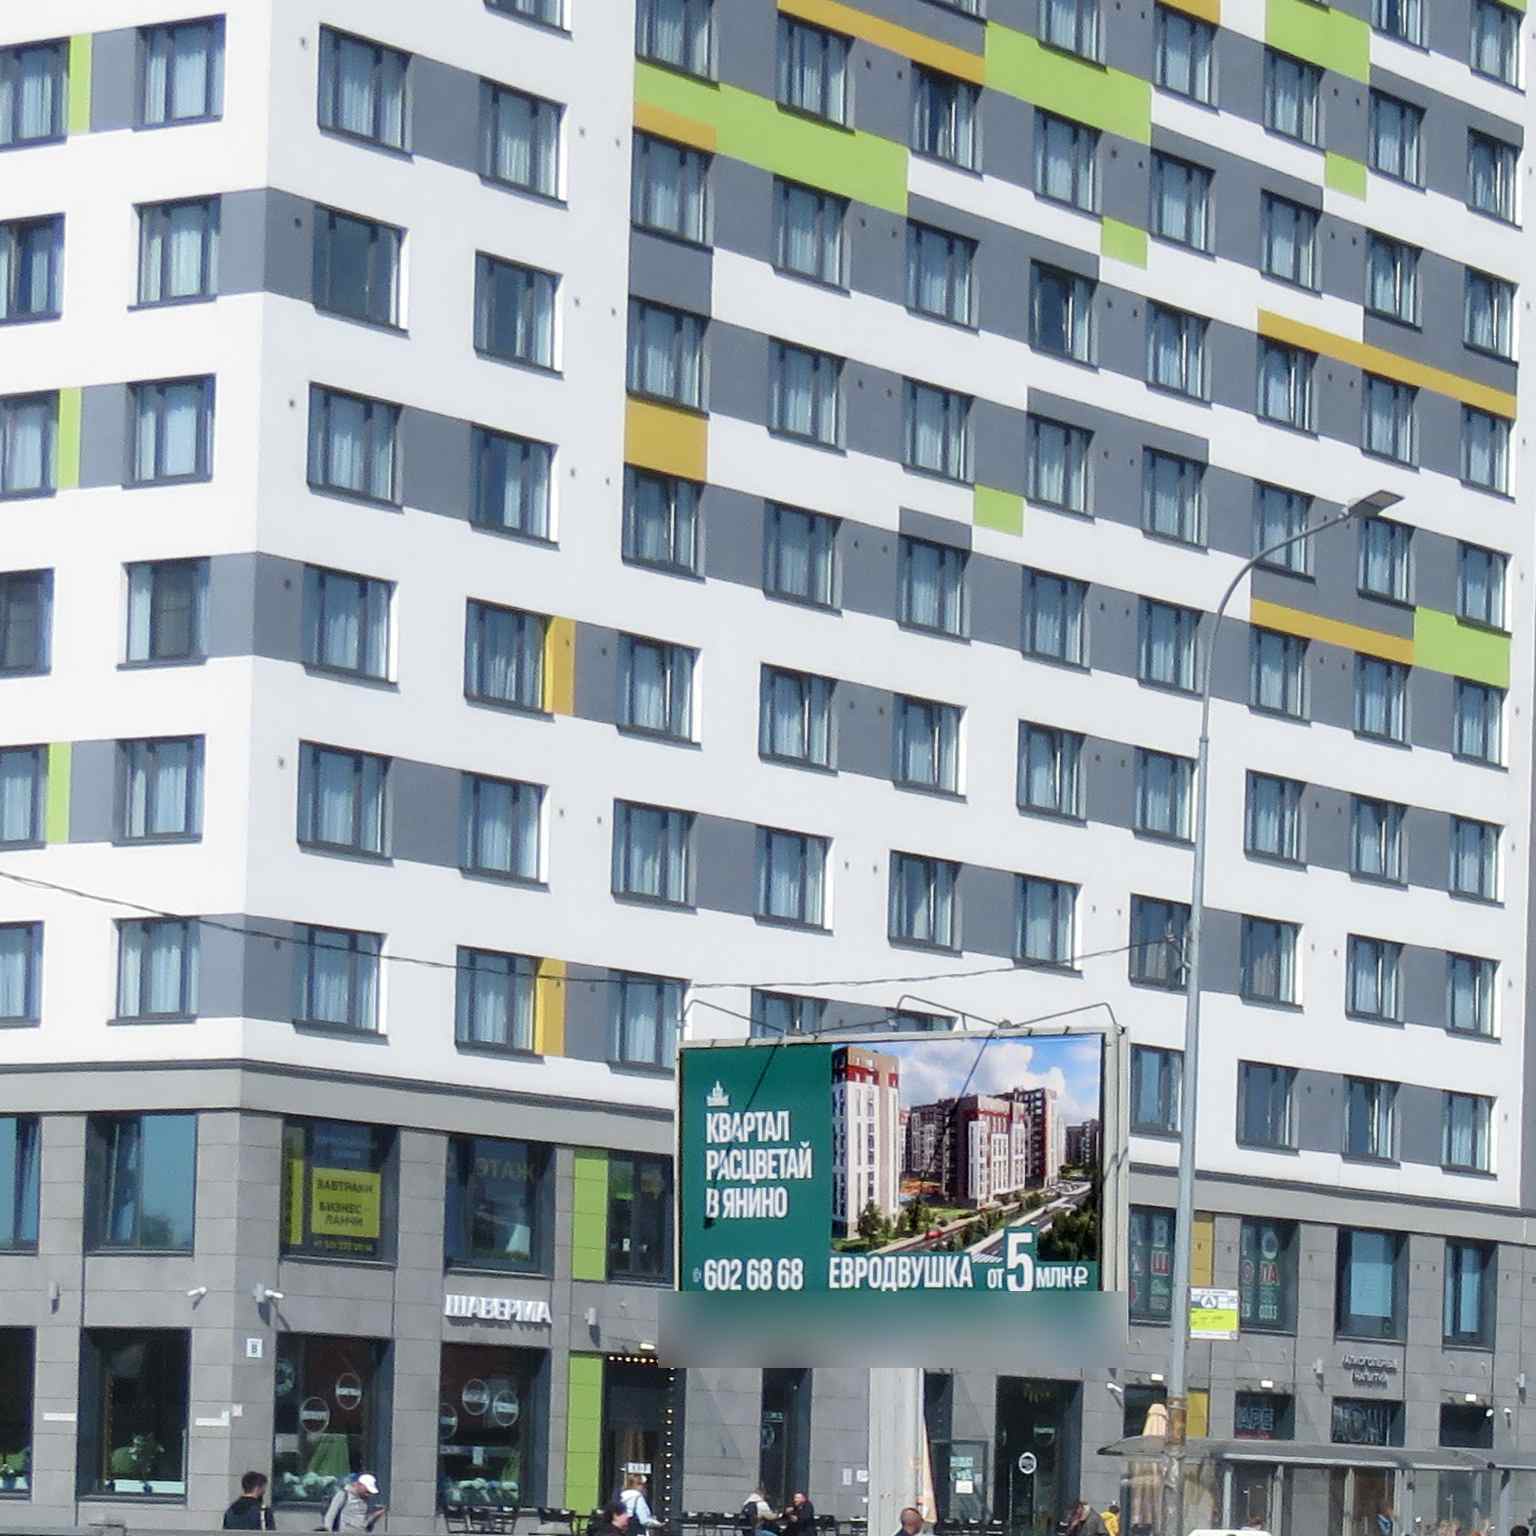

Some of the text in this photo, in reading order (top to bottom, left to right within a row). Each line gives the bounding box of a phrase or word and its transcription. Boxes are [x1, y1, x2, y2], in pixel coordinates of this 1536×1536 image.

[706, 1110, 790, 1143] КВАРТАЛ
[706, 1141, 813, 1184] РАСЦВЕТАЙ
[706, 1187, 788, 1218] В ЯНИНО
[704, 1258, 804, 1290] 602 68 68
[828, 1254, 973, 1292] ЕВРОДВУШКА
[1007, 1232, 1033, 1292] 5
[444, 1294, 552, 1323] ШАВЕРМА
